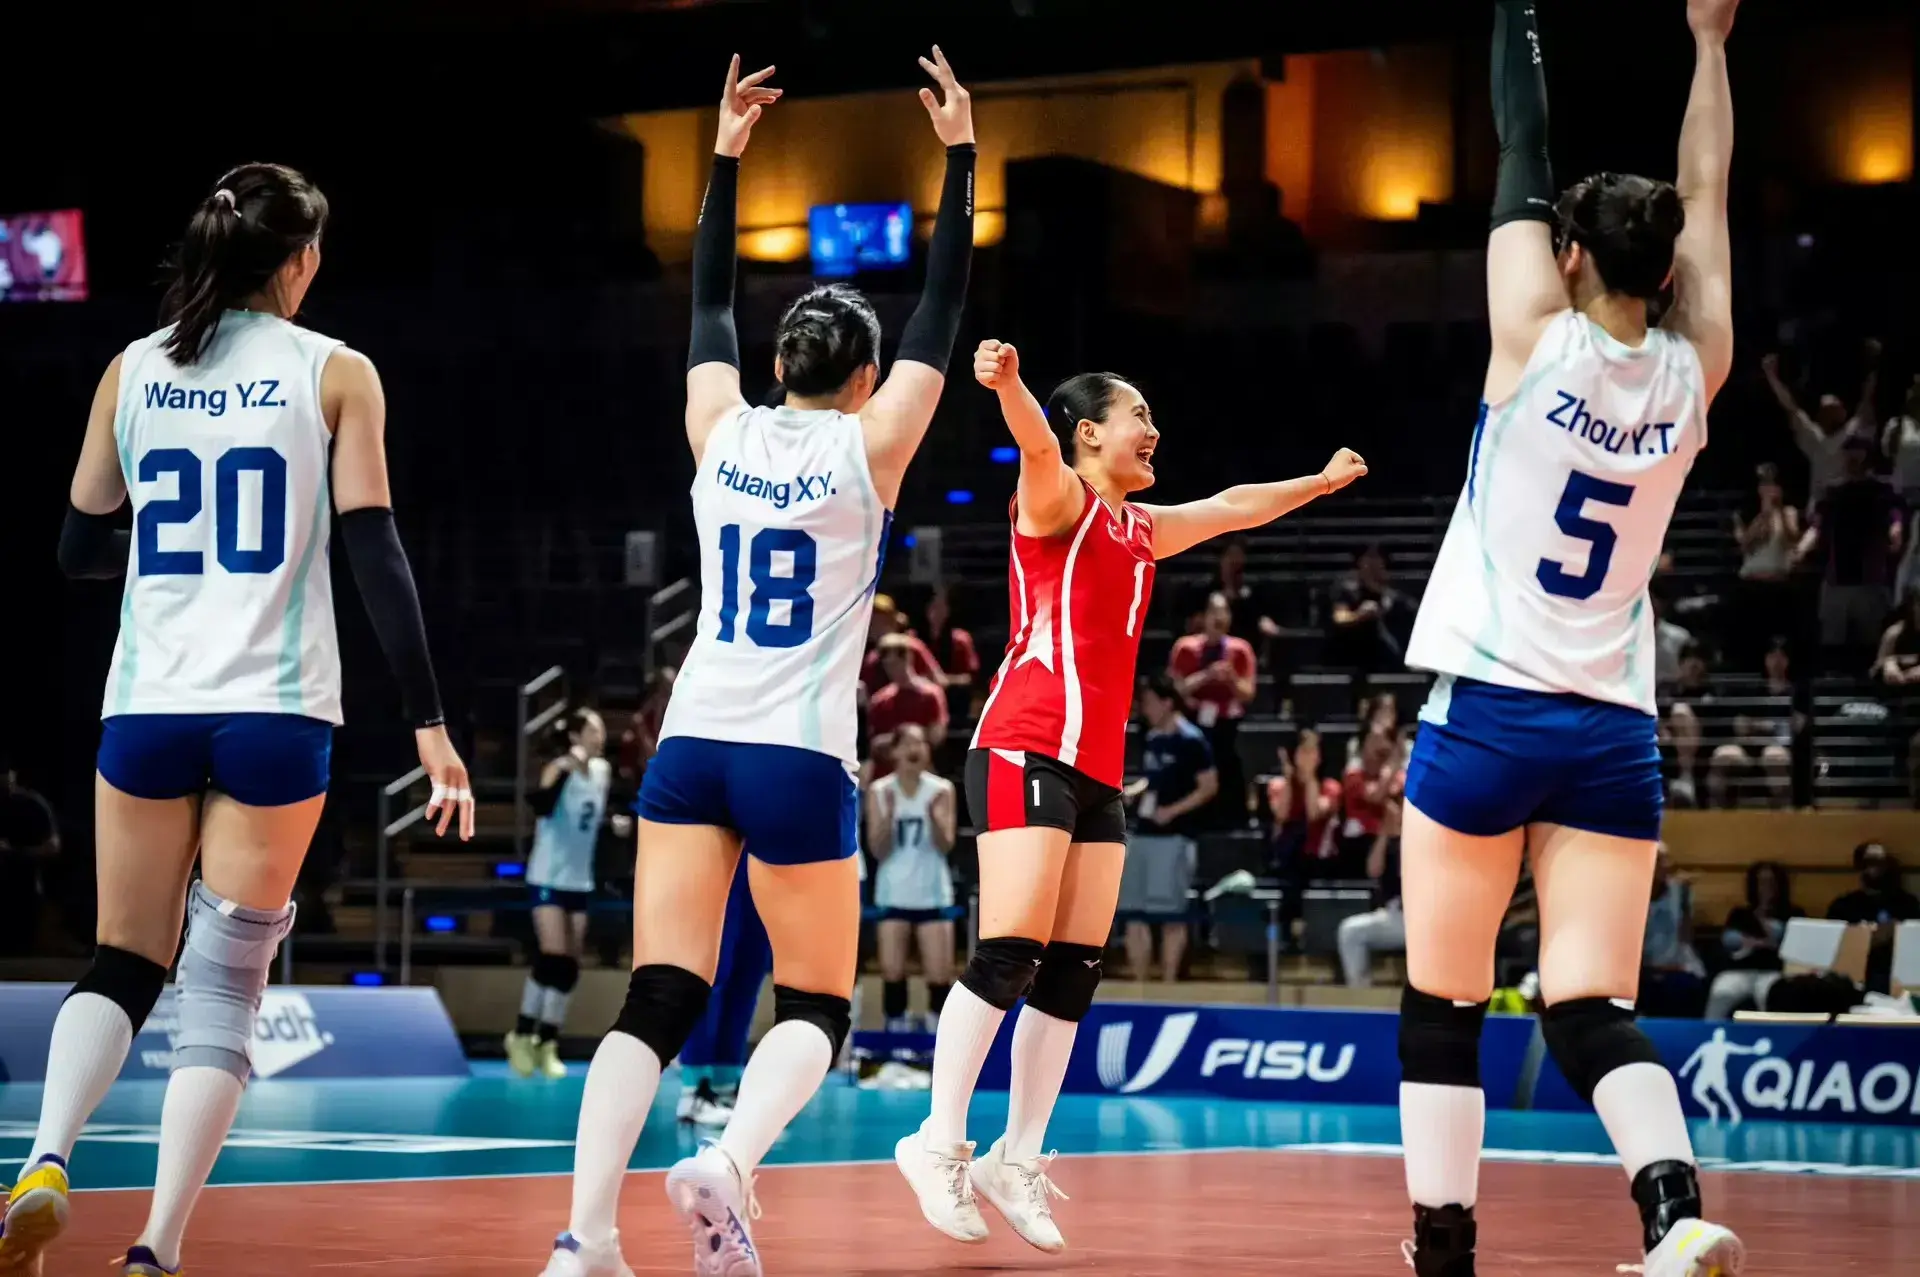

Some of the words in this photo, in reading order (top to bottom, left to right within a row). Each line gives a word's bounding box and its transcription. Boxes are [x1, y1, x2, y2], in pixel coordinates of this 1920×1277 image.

[145, 381, 227, 417] Wang
[236, 380, 287, 408] Y.Z.
[1546, 390, 1629, 454] Zhou
[1631, 422, 1679, 456] Y.T.
[137, 446, 287, 576] 20
[717, 460, 790, 509] Huang
[795, 471, 837, 502] X.Y.
[1536, 469, 1637, 600] 5
[716, 523, 817, 649] 18
[1126, 560, 1147, 637] 1
[1031, 779, 1041, 807] 1
[897, 816, 924, 848] 17
[1200, 1037, 1357, 1083] FISU
